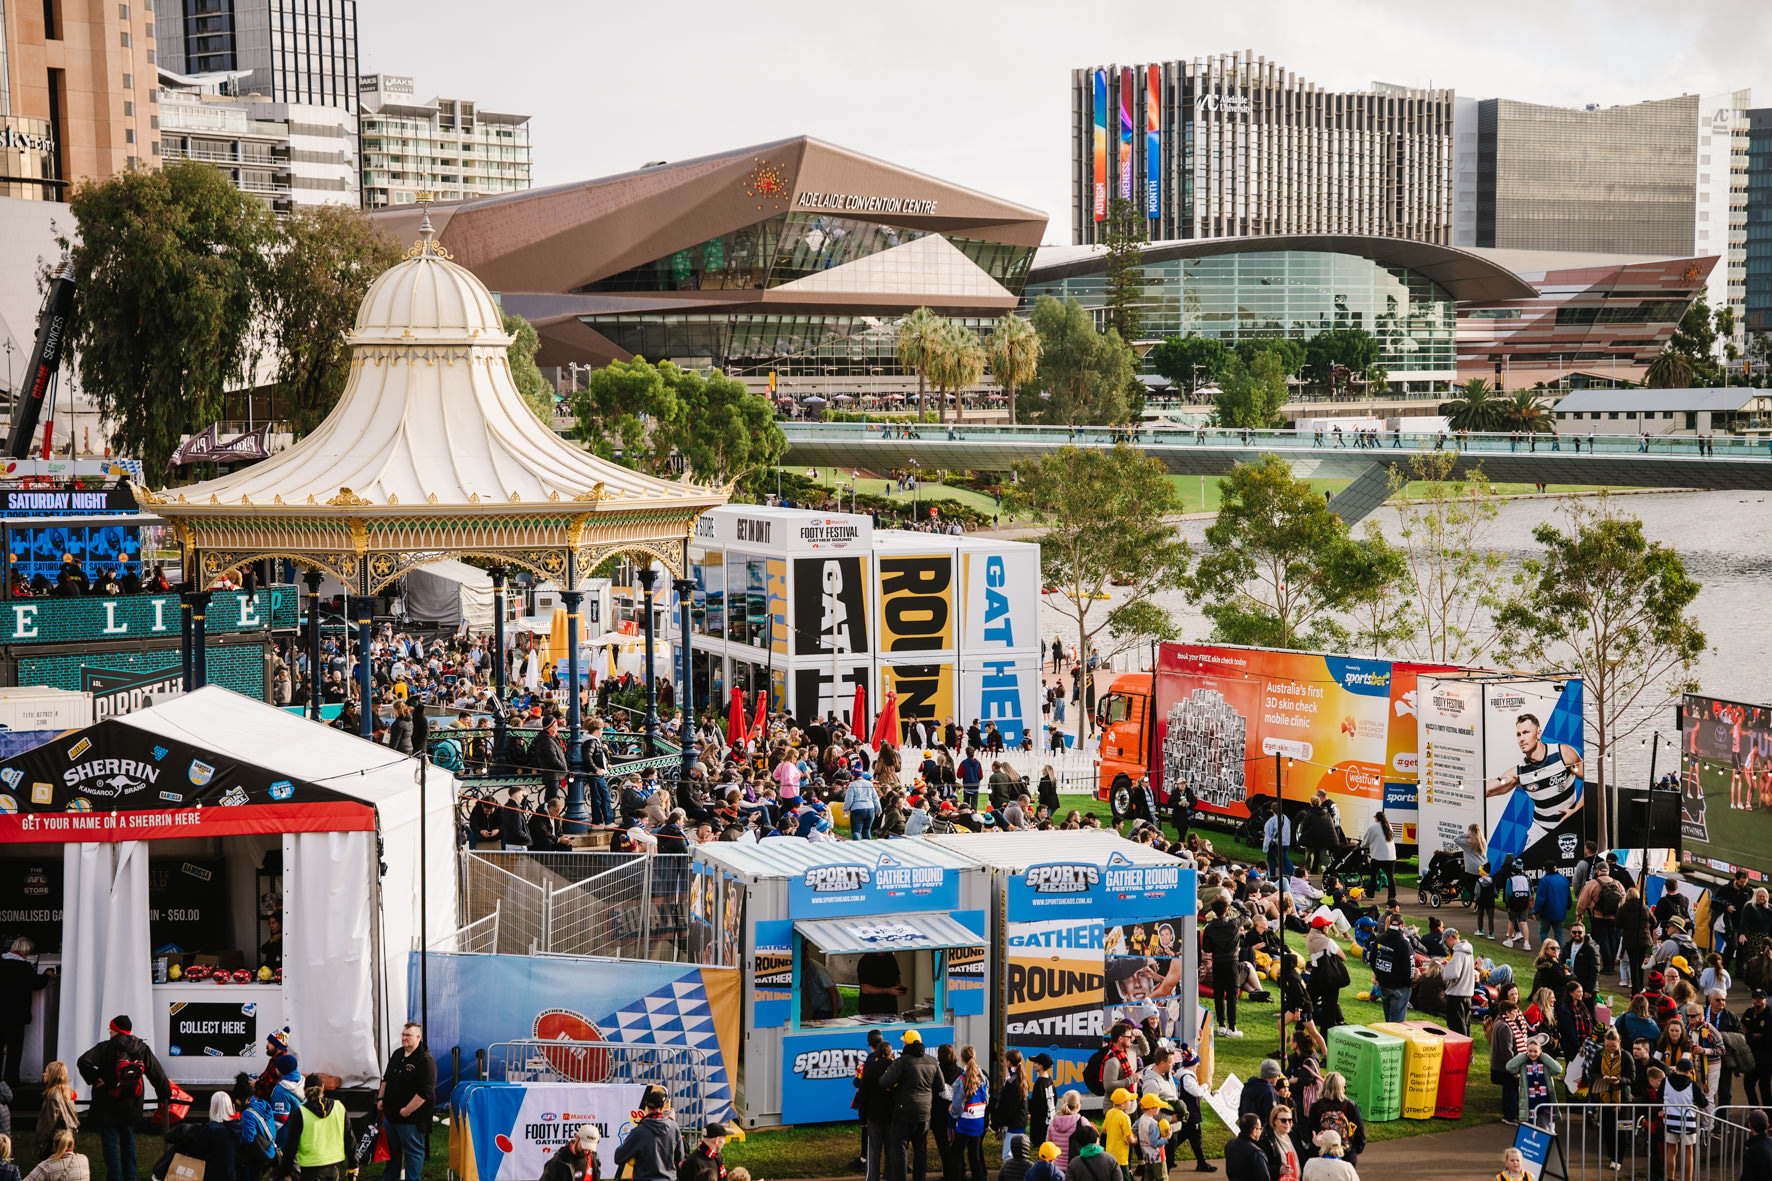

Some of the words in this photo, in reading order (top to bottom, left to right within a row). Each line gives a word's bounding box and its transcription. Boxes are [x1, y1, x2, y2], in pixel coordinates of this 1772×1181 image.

[1121, 161, 1131, 201] ARENESS
[798, 191, 846, 209] ADELAIDE
[845, 194, 903, 213] CONVENTION
[902, 198, 938, 215] CENTRE
[1095, 182, 1104, 215] AUTISM
[1149, 180, 1158, 212] MONTH
[43, 315, 64, 360] SERVICES
[32, 363, 49, 399] CRANE
[48, 463, 66, 474] Kayo
[8, 493, 70, 509] SATURDAY
[72, 493, 107, 509] NIGHT
[699, 516, 715, 538] STORE
[737, 518, 748, 541] GET
[748, 519, 755, 541] IN
[755, 521, 764, 542] ON
[764, 522, 771, 543] IT
[800, 527, 824, 539] FOOTY
[826, 526, 859, 538] FESTIVAL
[817, 560, 856, 724] GATHE
[1177, 652, 1188, 660] Book
[1188, 653, 1199, 662] your
[1199, 654, 1211, 663] FREE
[1211, 656, 1221, 664] skin
[1221, 656, 1234, 665] check
[1234, 658, 1247, 668] today
[1345, 672, 1386, 687] sportsbet
[1266, 682, 1307, 696] Australia's
[1308, 683, 1324, 698] first
[1265, 697, 1278, 709] 3D
[1278, 698, 1294, 710] skin
[1295, 699, 1318, 713] check
[1433, 696, 1447, 708] FOOTY
[1447, 698, 1465, 711] FESTIVAL
[1491, 698, 1505, 707] FOOTY
[1506, 697, 1526, 705] FESTIVAL
[1264, 713, 1290, 726] mobile
[1290, 715, 1311, 728] clinic
[63, 758, 160, 787] SHERRIN
[1549, 773, 1567, 786] Ford
[78, 785, 114, 796] KANGAROO
[124, 782, 146, 795] BRAND
[22, 817, 40, 830] GET
[41, 817, 70, 830] YOUR
[72, 816, 102, 829] NAME
[103, 815, 118, 828] ON
[119, 815, 127, 828] A
[128, 813, 172, 828] SHERRIN
[174, 812, 201, 825] HERE
[805, 865, 871, 886] SPORTS
[876, 868, 911, 885] GATHER
[912, 867, 944, 883] ROUND
[1025, 865, 1100, 886] SPORTS
[1105, 870, 1143, 887] GATHER
[1144, 868, 1179, 886] ROUND
[815, 882, 860, 892] HEADS
[1037, 882, 1087, 892] HEADS
[811, 895, 866, 904] WWW.SPORTSHEADS.COM.AU
[1032, 897, 1093, 906] WWW.SPORTSHEADS.COM.AU
[0, 909, 50, 922] SONALISED
[167, 908, 200, 921] $50.00
[1008, 923, 1104, 950] GATHER
[948, 946, 984, 960] ROUND
[754, 956, 793, 971] ROUND
[948, 963, 985, 973] GATHER
[754, 973, 793, 983] GATHER
[1007, 963, 1104, 1005] ROUND
[179, 1021, 221, 1034] COLLECT
[222, 1021, 246, 1034] HERE
[540, 1009, 563, 1017] GATHER
[564, 1010, 584, 1020] ROUND
[584, 1018, 603, 1037] GATHER
[1006, 1009, 1104, 1037] GATHER
[1335, 1037, 1362, 1050] ORGANICS
[793, 1049, 869, 1073] SPORTS
[1337, 1058, 1356, 1068] Cutlery
[1345, 1052, 1358, 1061] Food
[806, 1067, 857, 1079] HEADS
[1335, 1065, 1357, 1077] Crockery
[525, 1123, 560, 1140] FOOTY
